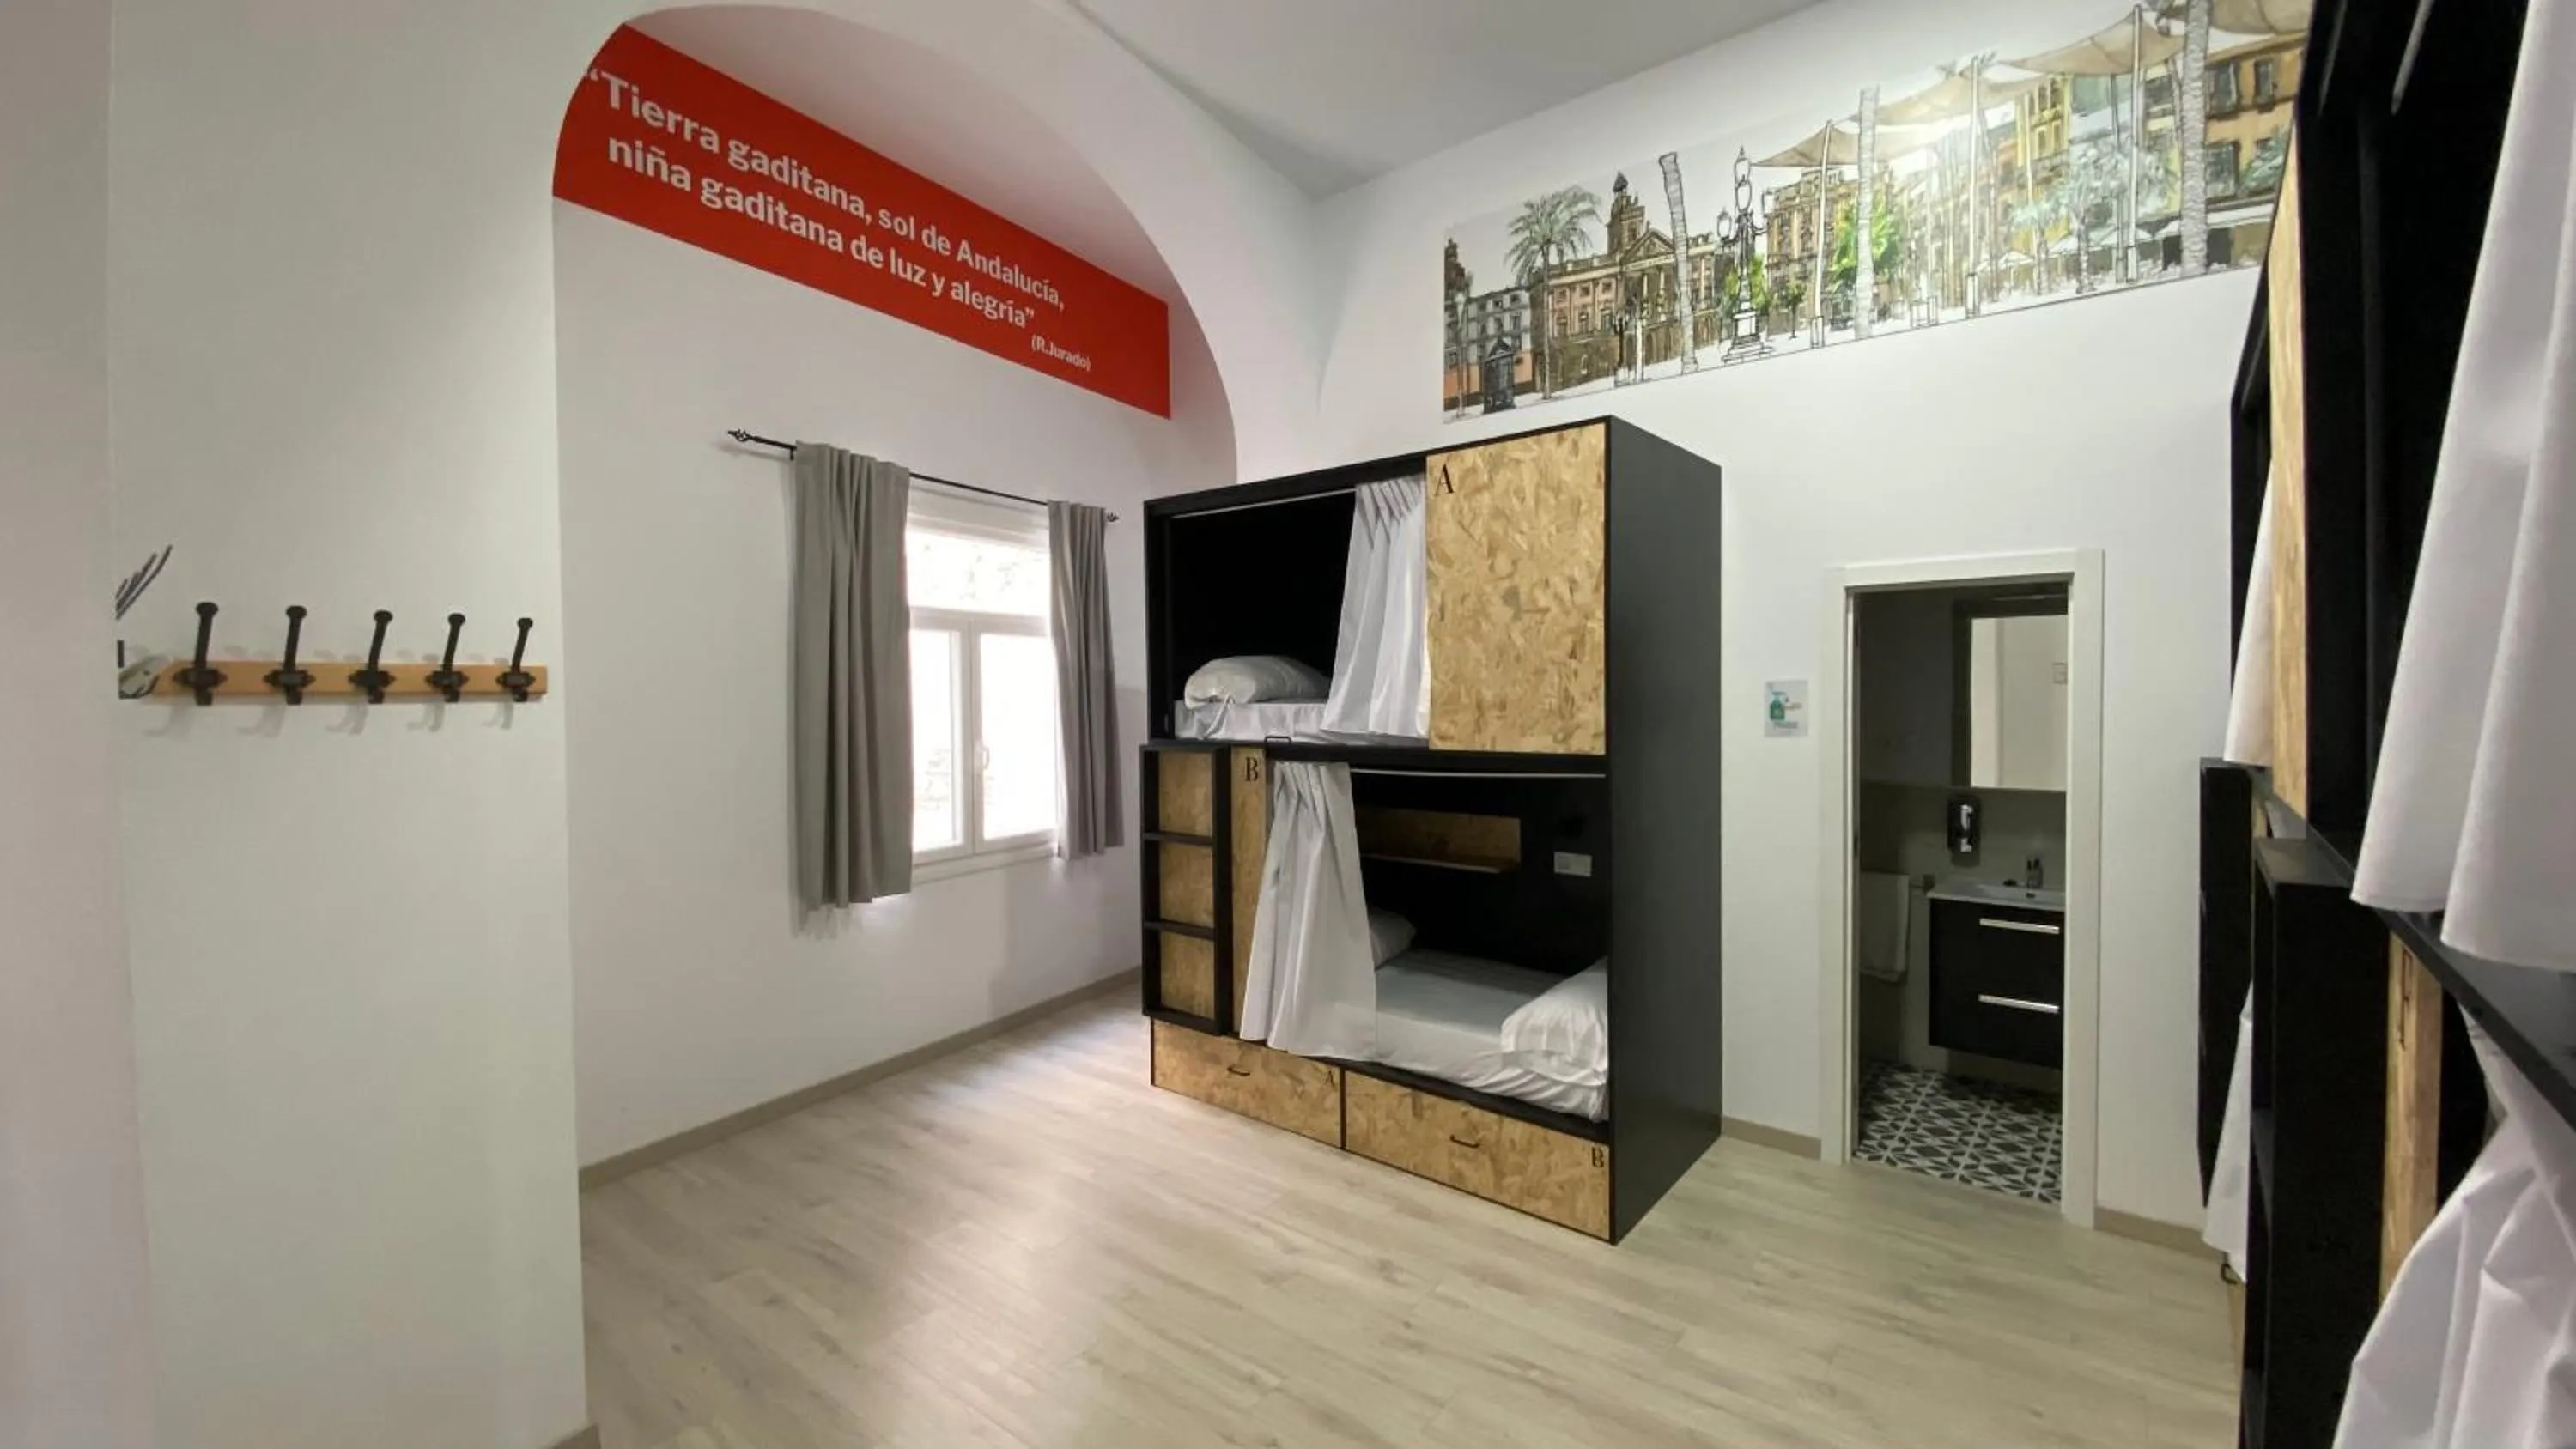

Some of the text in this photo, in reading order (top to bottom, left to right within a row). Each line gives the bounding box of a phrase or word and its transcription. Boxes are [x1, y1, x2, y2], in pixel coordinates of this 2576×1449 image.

[609, 136, 1035, 328] niña gaditana de luz y alegría”
[728, 139, 872, 226] gaditana,
[878, 209, 916, 241] sol
[921, 225, 951, 256] de
[957, 239, 1065, 312] Andalucía,
[1434, 463, 1455, 497] A
[1245, 755, 1259, 782] B
[1591, 1146, 1605, 1168] B
